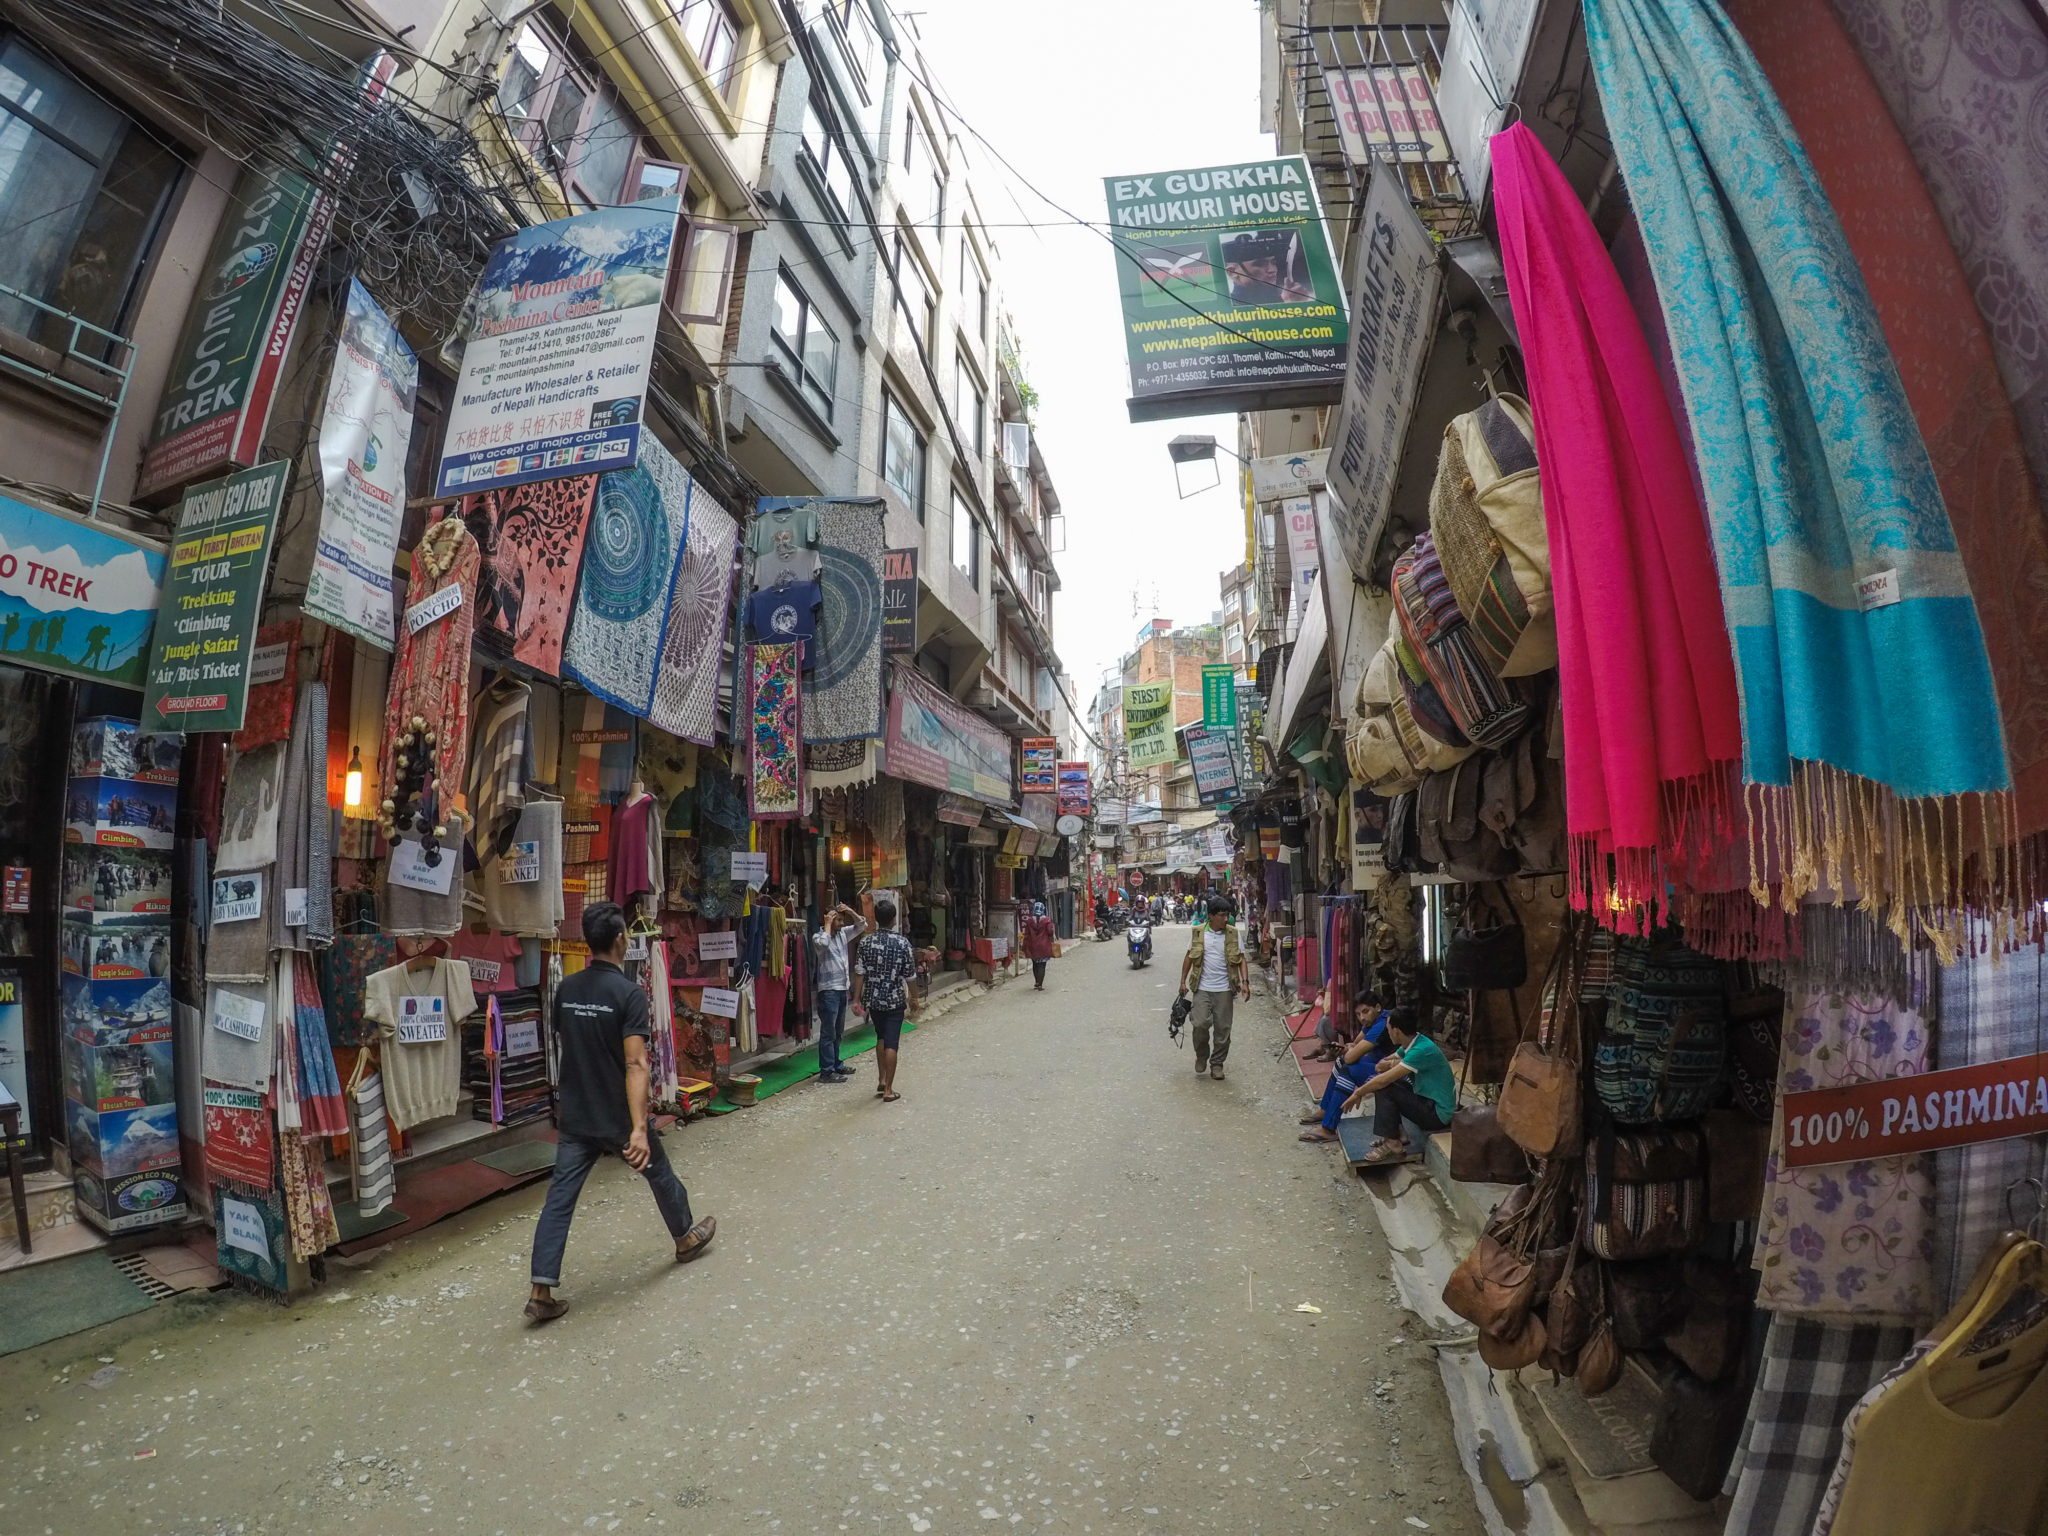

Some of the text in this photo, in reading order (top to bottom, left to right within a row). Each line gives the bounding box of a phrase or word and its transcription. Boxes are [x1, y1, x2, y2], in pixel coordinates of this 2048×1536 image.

[1334, 77, 1429, 104] CARGO
[1343, 109, 1440, 134] COURIER
[1114, 164, 1302, 201] EX GURKHA
[1117, 190, 1310, 228] KHUKURI HOUSE
[509, 266, 606, 306] Mountain
[1354, 211, 1396, 402] HANDICRAFTS
[480, 296, 605, 338] Pashmina Center
[544, 321, 594, 338] Kathmandu,
[596, 314, 622, 327] Nepal
[1131, 304, 1337, 333] www.nepalkhukurihouse.com
[499, 348, 513, 360] Tel:
[565, 326, 617, 344] 9851002867
[1142, 326, 1333, 354] www.nepalkukrihouse.com
[470, 334, 646, 377] E-mail: mountain.pashmina47@gmail.com
[1199, 356, 1214, 366] CPC
[1234, 352, 1263, 363] Thamel,
[1311, 347, 1335, 359] Nepal
[495, 359, 576, 383] mountainpashmina
[461, 363, 641, 406] Manufacture Wholesaler & Retailer
[160, 376, 241, 437] TREK
[490, 385, 600, 415] of Nepali Handicrafts
[592, 410, 613, 420] FREE
[454, 407, 586, 451] 不怕货比货 只怕不识货
[469, 430, 608, 462] We accept all major cards
[602, 442, 627, 454] SCT
[471, 465, 493, 478] VISA
[180, 472, 278, 529] MISSION ECO TREK
[202, 540, 226, 556] TIBET
[229, 530, 263, 550] BHUTAN
[175, 546, 200, 565] NEPAL
[191, 562, 232, 584] TOUR
[883, 552, 914, 581] INA
[26, 561, 94, 602] TREK
[409, 595, 460, 632] PONCHO
[202, 634, 239, 655] Safari
[202, 662, 241, 680] Ticket
[167, 695, 218, 710] GROUND FLOOR
[1131, 687, 1161, 705] FIRST
[571, 731, 629, 743] 100% Pashmina
[1129, 720, 1165, 740] TREKKING
[1131, 739, 1167, 758] PVT. LTD.
[1190, 735, 1226, 749] UNLOCK
[1240, 704, 1253, 780] HIMALAYAN
[145, 771, 180, 785] Trekking
[1197, 766, 1232, 781] INTERNET
[1200, 778, 1235, 792] SIM CARD
[565, 823, 600, 834] Pashmina
[101, 833, 138, 845] Climbing
[412, 865, 431, 873] BABY
[499, 865, 539, 883] BLANKET
[402, 873, 438, 887] YAK WOOL
[562, 881, 587, 891] shmere
[145, 902, 171, 913] Hiking
[287, 909, 306, 925] 100%
[560, 944, 590, 954] ashmere
[97, 968, 135, 979] Jungle Safari
[471, 967, 499, 981] EATER
[416, 1013, 444, 1023] CASHMERE
[225, 1017, 260, 1040] CASHMERE
[400, 1024, 446, 1042] SWEATER
[205, 1090, 262, 1108] 100% CASHMER
[1789, 1076, 2048, 1147] 100% PASHMINA
[111, 1171, 180, 1196] MISSION ECO TREK
[229, 1211, 249, 1224] YAK
[232, 1226, 262, 1243] BLAN
[1585, 1397, 1651, 1464] ELCOME
